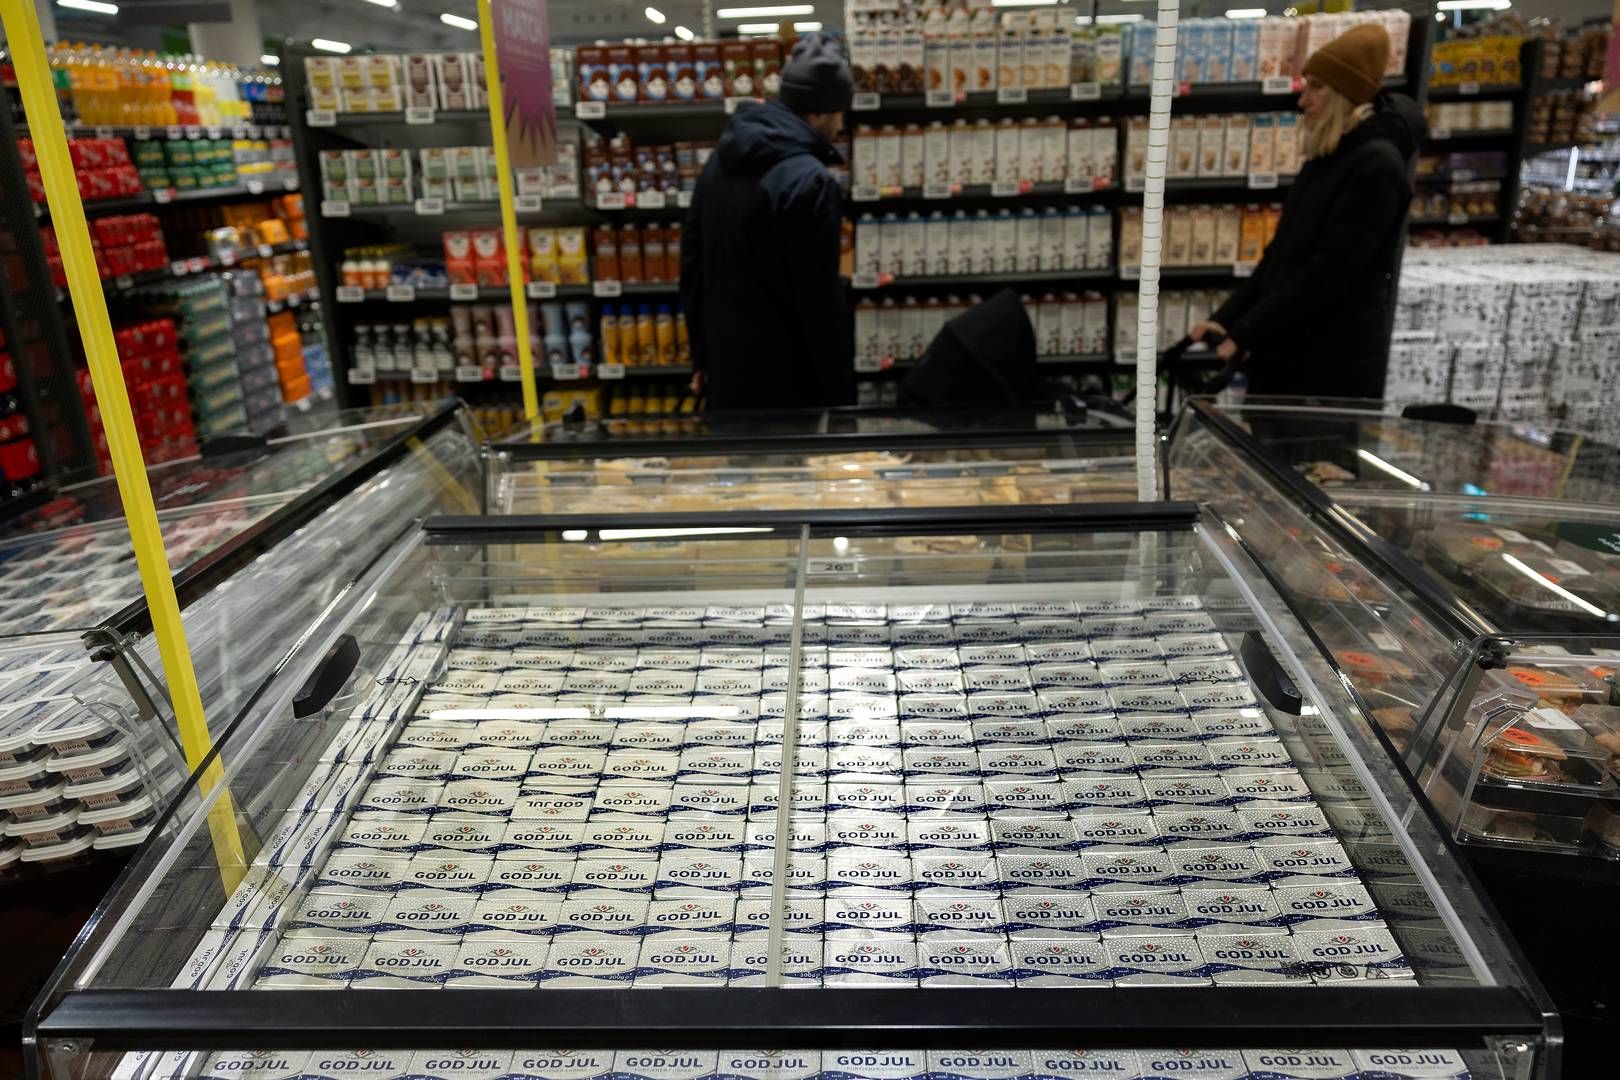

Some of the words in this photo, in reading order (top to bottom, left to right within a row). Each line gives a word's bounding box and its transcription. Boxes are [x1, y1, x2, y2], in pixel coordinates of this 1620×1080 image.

[58, 743, 87, 752] LURPAK
[1203, 823, 1233, 831] JUL
[1253, 821, 1288, 829] GOD
[1289, 819, 1320, 828] JUL
[837, 831, 869, 839] GOD
[1083, 829, 1117, 838] GOD
[1118, 827, 1148, 836] JUL
[432, 834, 464, 842] GOD
[1182, 863, 1218, 872] GOD
[1219, 862, 1251, 871] JUL
[1272, 858, 1308, 868] GOD
[1310, 856, 1342, 866] JUL
[328, 869, 362, 877] GOD
[362, 870, 391, 879] JUL
[668, 870, 701, 878] GOD
[921, 870, 955, 880] GOD
[957, 870, 987, 878] JUL
[1009, 870, 1044, 878] GOD
[1045, 868, 1076, 878] JUL
[1095, 866, 1130, 875] GOD
[1132, 865, 1163, 874] JUL
[414, 871, 447, 880] GOD
[500, 872, 533, 880] GOD
[585, 872, 618, 880] GOD
[236, 893, 248, 908] GOD
[247, 881, 257, 894] JUL
[1196, 905, 1233, 914] GOD
[1235, 904, 1268, 913] JUL
[1290, 900, 1328, 910] GOD
[1330, 898, 1364, 908] JUL
[306, 910, 341, 918] GOD
[341, 910, 372, 920] JUL
[395, 912, 430, 921] GOD
[430, 912, 461, 920] JUL
[656, 912, 690, 922] GOD
[692, 911, 722, 920] JUL
[747, 913, 770, 921] GO
[784, 912, 814, 921] JUL
[836, 911, 870, 920] GOD
[872, 911, 903, 919] JUL
[927, 912, 963, 921] GOD
[965, 912, 997, 920] JUL
[1015, 910, 1051, 919] GOD
[1053, 910, 1085, 919] JUL
[1106, 908, 1142, 917] GOD
[1144, 906, 1177, 916] JUL
[482, 913, 517, 921] GOD
[518, 913, 548, 922] JUL
[569, 913, 603, 921] GOD
[604, 914, 635, 922] JUL
[1215, 950, 1254, 959] GOD
[1255, 949, 1291, 959] JUL
[1312, 946, 1351, 957] GOD
[1354, 944, 1389, 954] JUL
[191, 960, 204, 978] GOD
[202, 947, 214, 961] JUL
[281, 954, 317, 964] GOD
[318, 955, 349, 964] JUL
[374, 957, 411, 967] GOD
[411, 958, 442, 967] JUL
[463, 957, 499, 966] GOD
[500, 958, 532, 966] JUL
[556, 958, 593, 966] GOD
[594, 957, 626, 966] JUL
[650, 955, 686, 964] GOD
[687, 954, 720, 963] JUL
[745, 956, 768, 964] GO
[782, 955, 814, 964] JUL
[835, 954, 872, 963] GOD
[873, 955, 906, 964] JUL
[928, 955, 966, 965] GOD
[967, 956, 1001, 965] JUL
[1023, 956, 1061, 965] GOD
[1063, 955, 1097, 965] JUL
[1118, 954, 1157, 963] GOD
[1158, 953, 1192, 963] JUL
[226, 962, 240, 979] GOD
[238, 949, 248, 962] JUL
[522, 1059, 563, 1069] GOD
[564, 1058, 600, 1068] JUL
[626, 1057, 666, 1068] GOD
[668, 1058, 703, 1068] JUL
[730, 1059, 771, 1069] GOD
[773, 1058, 808, 1069] JUL
[837, 1056, 877, 1066] GOD
[880, 1056, 915, 1066] JUL
[939, 1057, 980, 1067] GOD
[983, 1057, 1020, 1067] JUL
[1259, 1056, 1302, 1066] GOD
[1305, 1056, 1342, 1066] JUL
[1369, 1054, 1412, 1065] GOD
[1415, 1054, 1453, 1065] JUL
[214, 1060, 254, 1070] GOD
[255, 1060, 290, 1070] JUL
[319, 1060, 359, 1070] GOD
[360, 1060, 395, 1070] JUL
[425, 1060, 465, 1070] GOD
[466, 1060, 501, 1070] JUL
[1044, 1059, 1086, 1070] GOD
[1089, 1060, 1126, 1071] JUL
[1151, 1060, 1193, 1071] GOD
[1196, 1059, 1233, 1070] JUL
